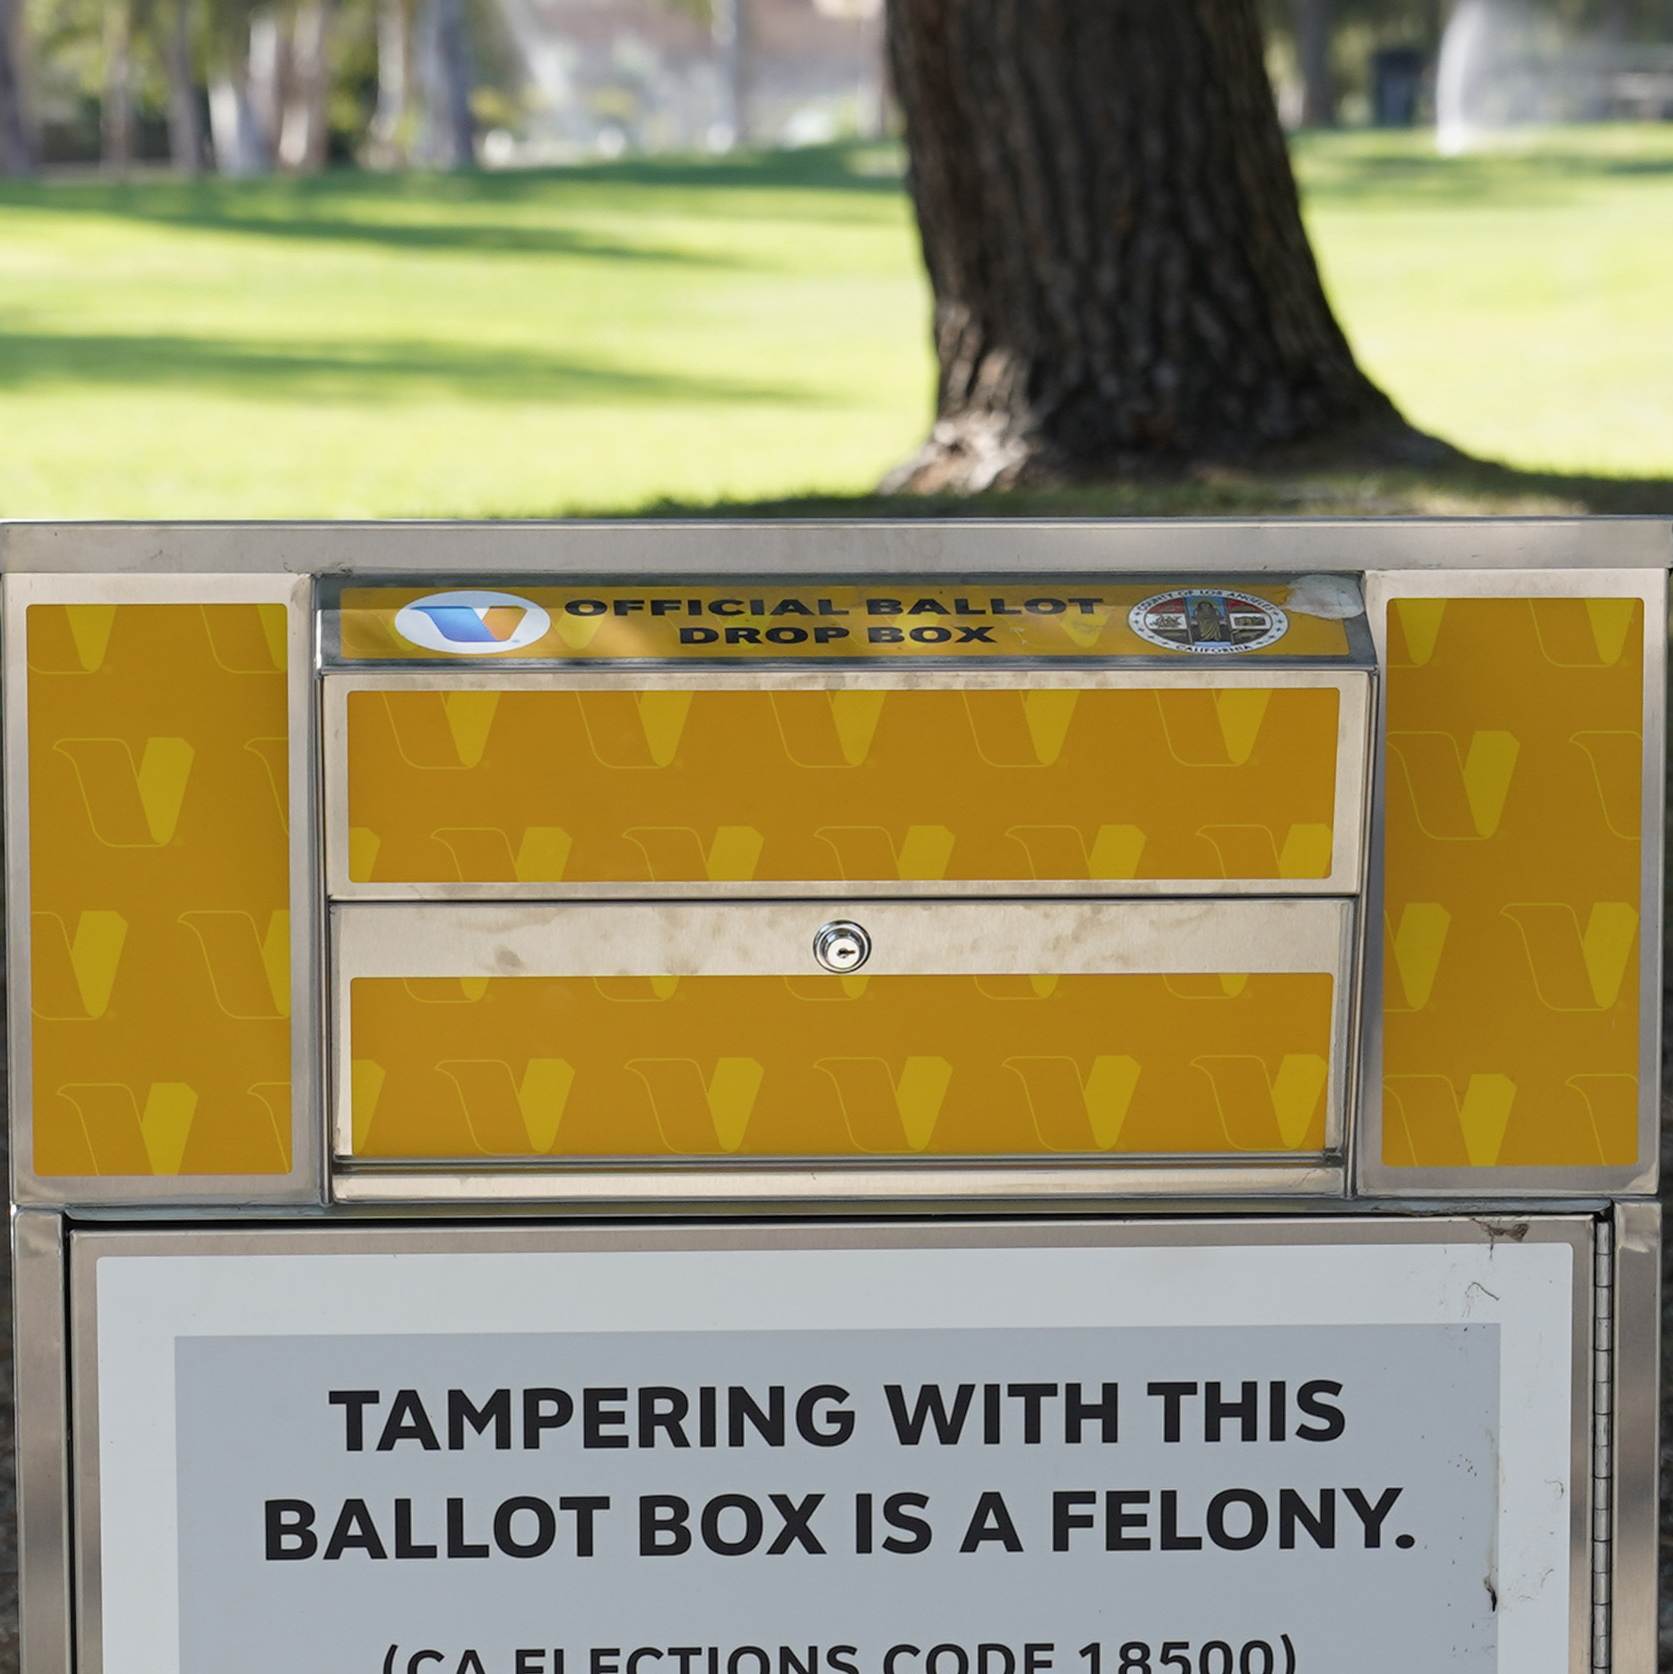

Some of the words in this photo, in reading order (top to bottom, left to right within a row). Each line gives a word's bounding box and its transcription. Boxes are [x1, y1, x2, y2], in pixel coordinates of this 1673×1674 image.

[1200, 588, 1223, 596] LOS
[563, 598, 850, 617] OFFICIAL
[865, 596, 1104, 616] BALLOT
[678, 625, 850, 645] DROP
[866, 625, 999, 644] BOX
[1176, 644, 1253, 653] CALIFORNIA
[328, 1384, 856, 1452] TAMPERING
[883, 1382, 1119, 1446] WITH
[1146, 1379, 1346, 1443] THIS
[264, 1495, 611, 1561] BALLOT
[639, 1493, 827, 1557] BOX
[855, 1491, 933, 1555] IS
[959, 1491, 1024, 1553] A
[1052, 1487, 1416, 1552] FELONY.
